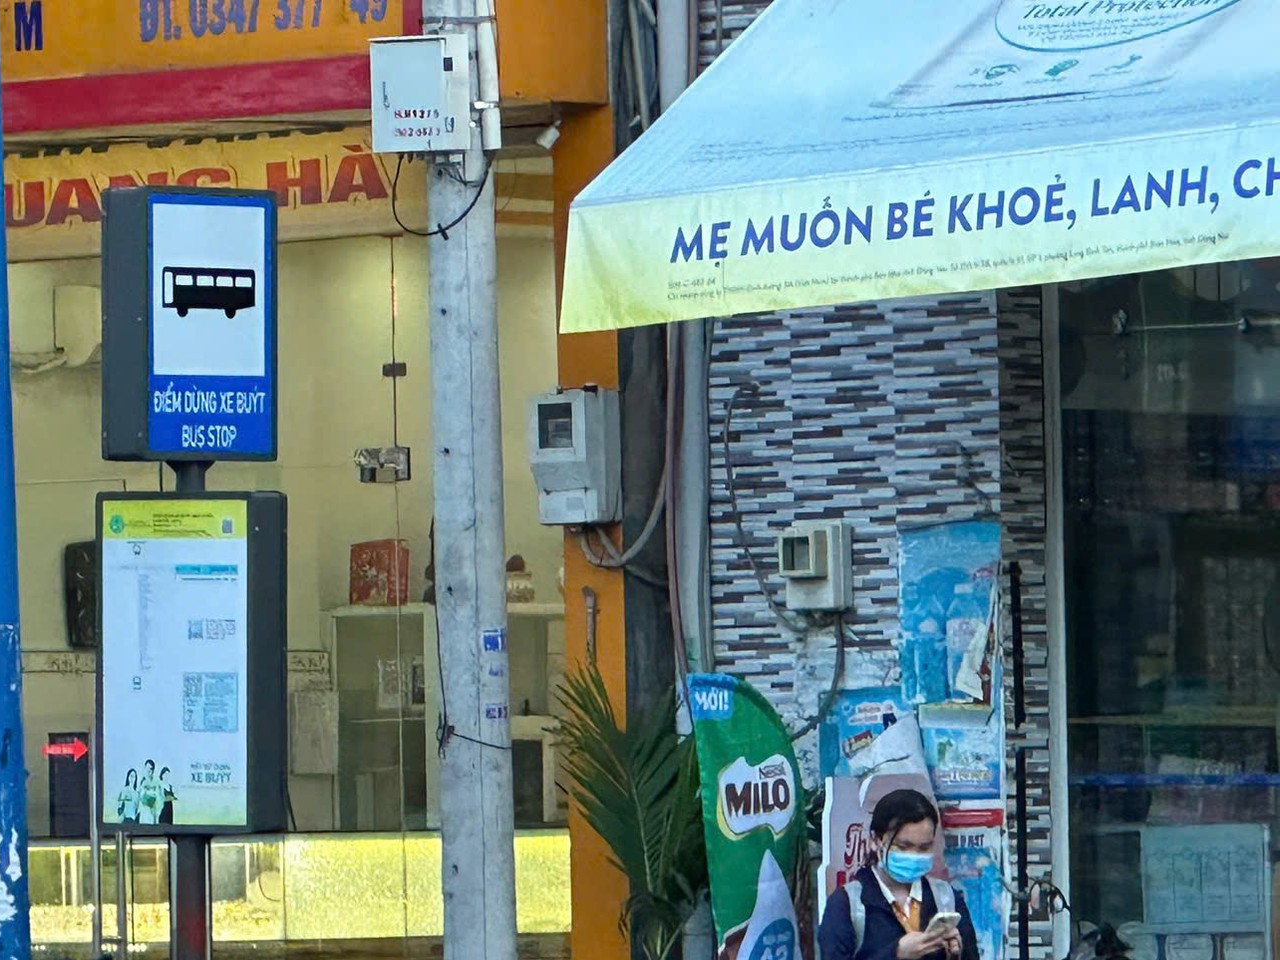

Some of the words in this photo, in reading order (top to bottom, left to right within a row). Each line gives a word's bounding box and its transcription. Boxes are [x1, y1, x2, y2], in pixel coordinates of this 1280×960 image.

[265, 143, 389, 209] HÀ
[669, 221, 731, 268] MẸ
[740, 195, 872, 256] MUỐN
[886, 190, 936, 240] BÉ
[947, 173, 1076, 234] KHOẺ,
[1091, 165, 1220, 214] LANH,
[219, 391, 235, 414] XE
[236, 385, 266, 414] BUÝT
[182, 424, 205, 448] BUS
[207, 424, 237, 448] STOP
[725, 778, 790, 818] MILO
